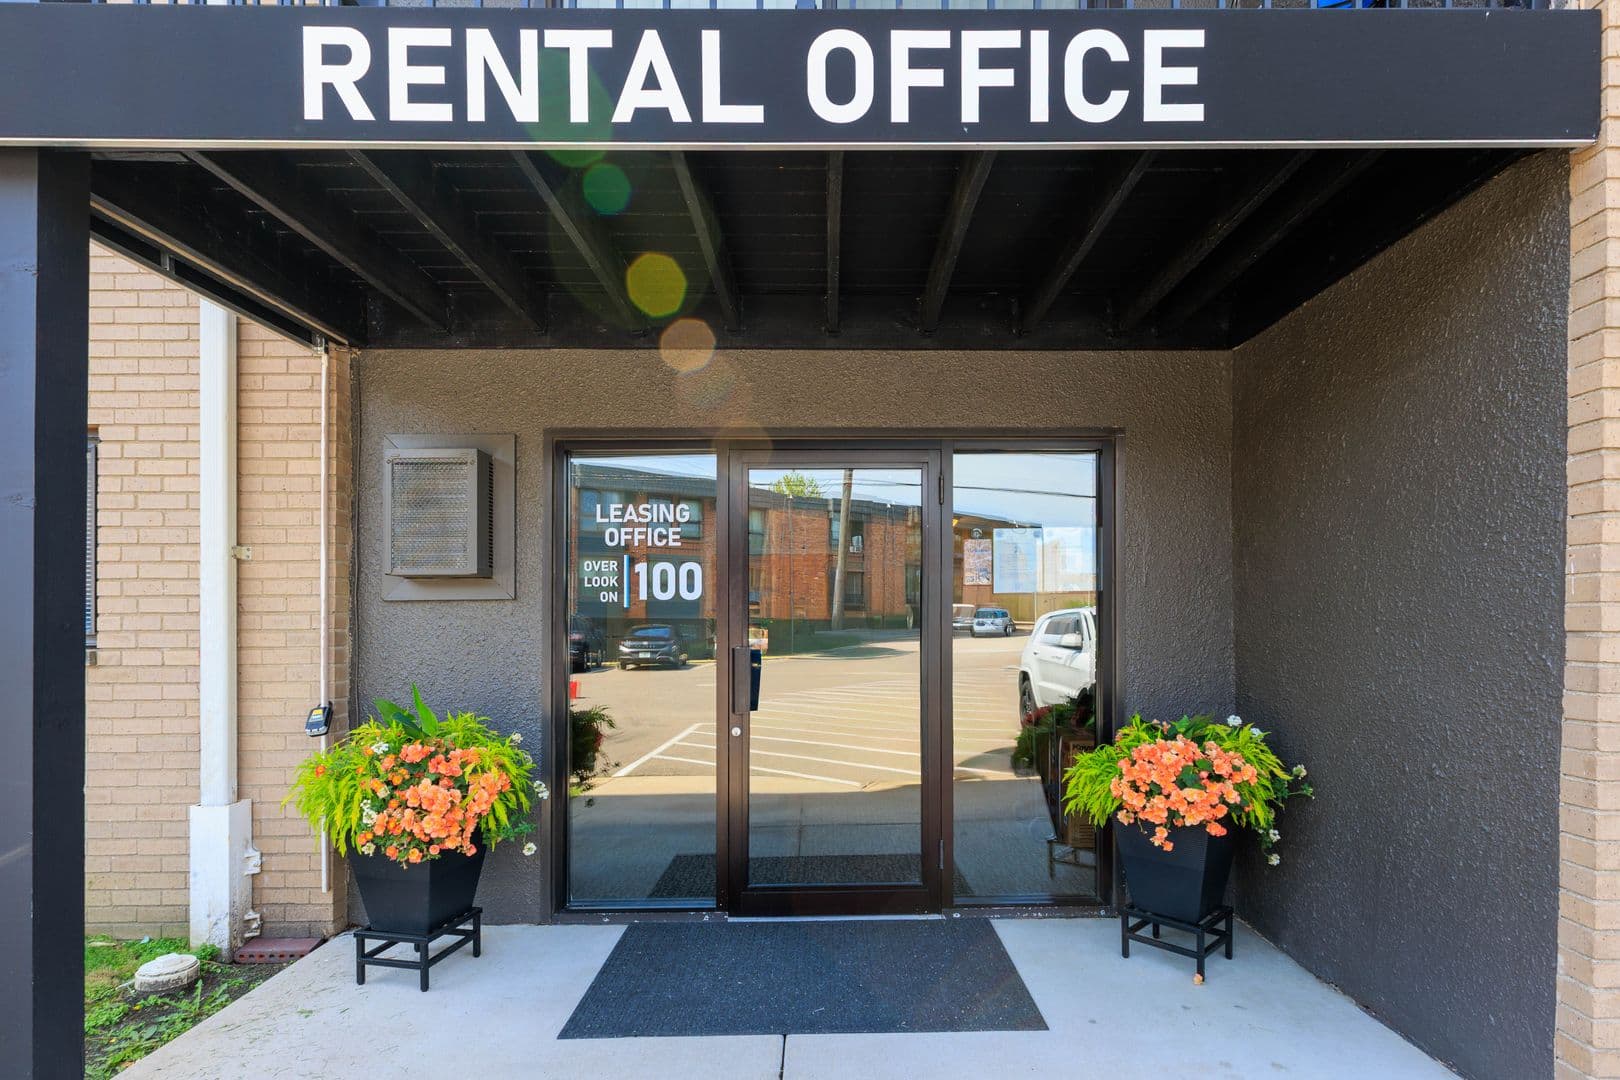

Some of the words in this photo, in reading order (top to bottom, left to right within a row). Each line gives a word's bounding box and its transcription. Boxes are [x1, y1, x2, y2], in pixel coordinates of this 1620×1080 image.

[302, 26, 765, 123] RENTAL
[806, 28, 1206, 124] OFFICE
[596, 503, 690, 522] LEASING
[605, 527, 681, 546] OFFICE
[583, 560, 618, 572] OVER
[584, 576, 618, 587] LOOK
[634, 561, 702, 600] 100
[600, 591, 618, 603] ON
